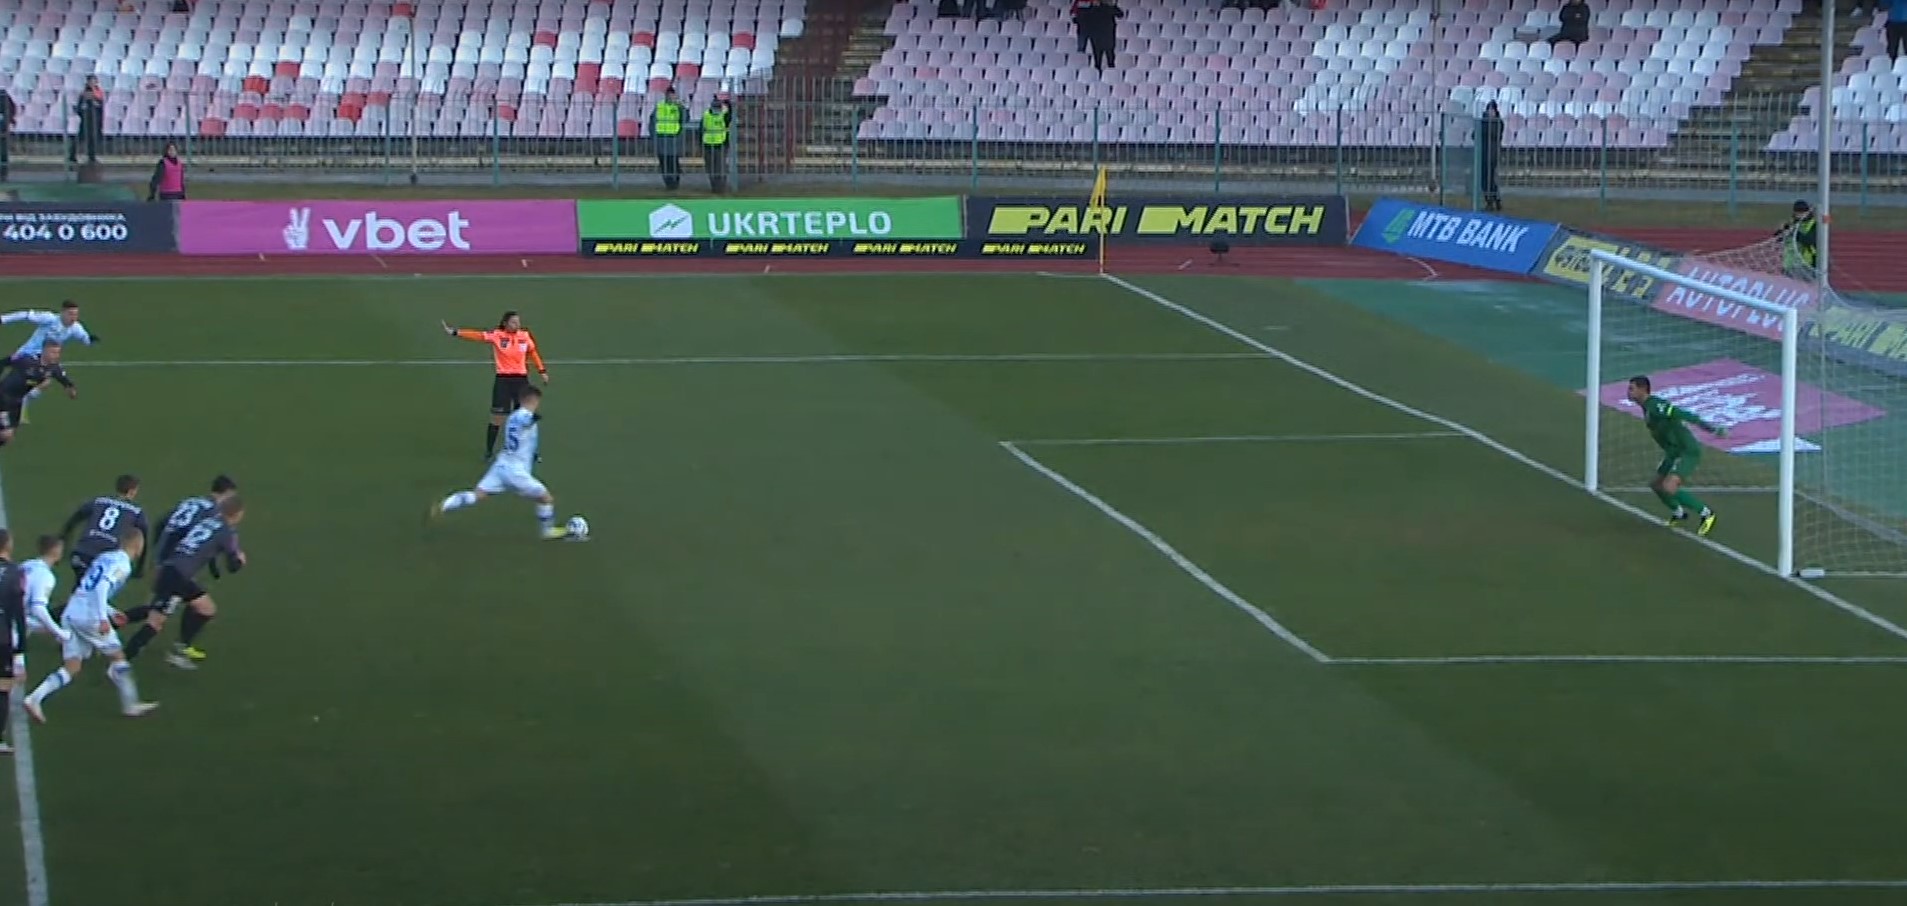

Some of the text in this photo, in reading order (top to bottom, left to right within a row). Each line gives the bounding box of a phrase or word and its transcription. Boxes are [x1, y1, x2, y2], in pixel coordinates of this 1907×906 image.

[3, 224, 128, 240] 404 0 600
[323, 210, 471, 251] vbet
[708, 211, 892, 235] UKRTEPLO
[988, 206, 1325, 234] PARI MATCH
[1407, 211, 1529, 252] MTB BANK
[98, 506, 120, 530] 8
